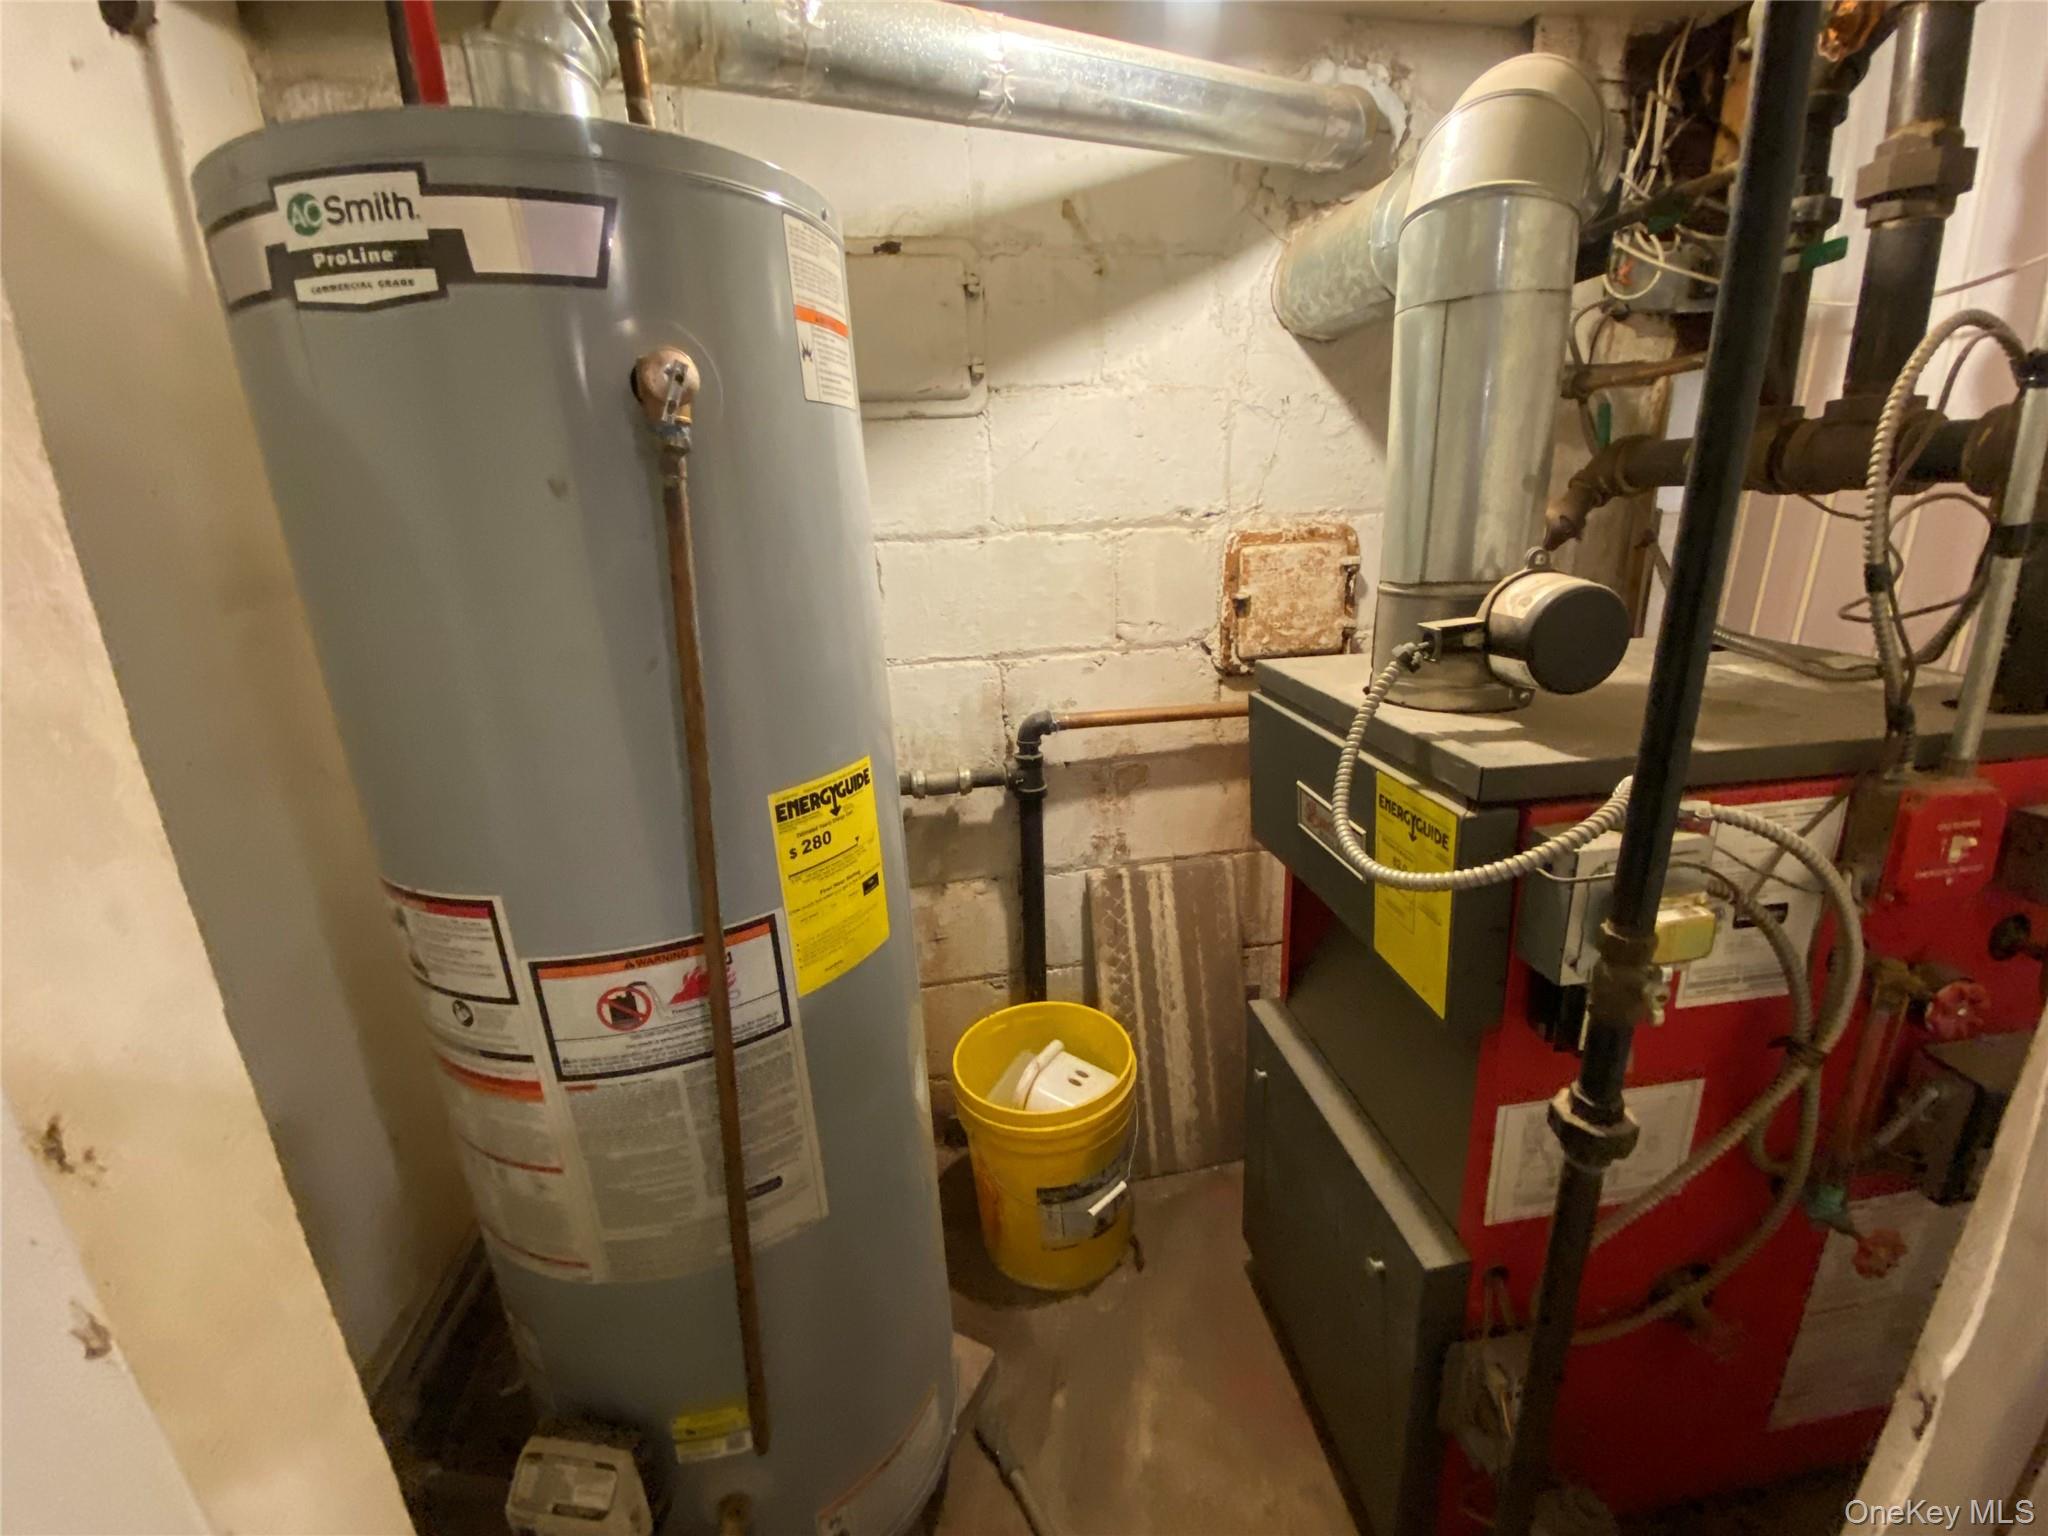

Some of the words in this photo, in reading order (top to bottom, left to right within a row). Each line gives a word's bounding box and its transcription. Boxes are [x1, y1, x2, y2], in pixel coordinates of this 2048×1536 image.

[312, 247, 394, 269] ProLine
[311, 281, 373, 295] COMMERCIAL
[378, 278, 415, 287] GRADE
[775, 768, 870, 823] ENERGYGUIDE
[1379, 794, 1449, 851] ENERGYGUIDE
[789, 848, 798, 860] $
[801, 831, 832, 855] 280
[635, 949, 690, 969] WARNING
